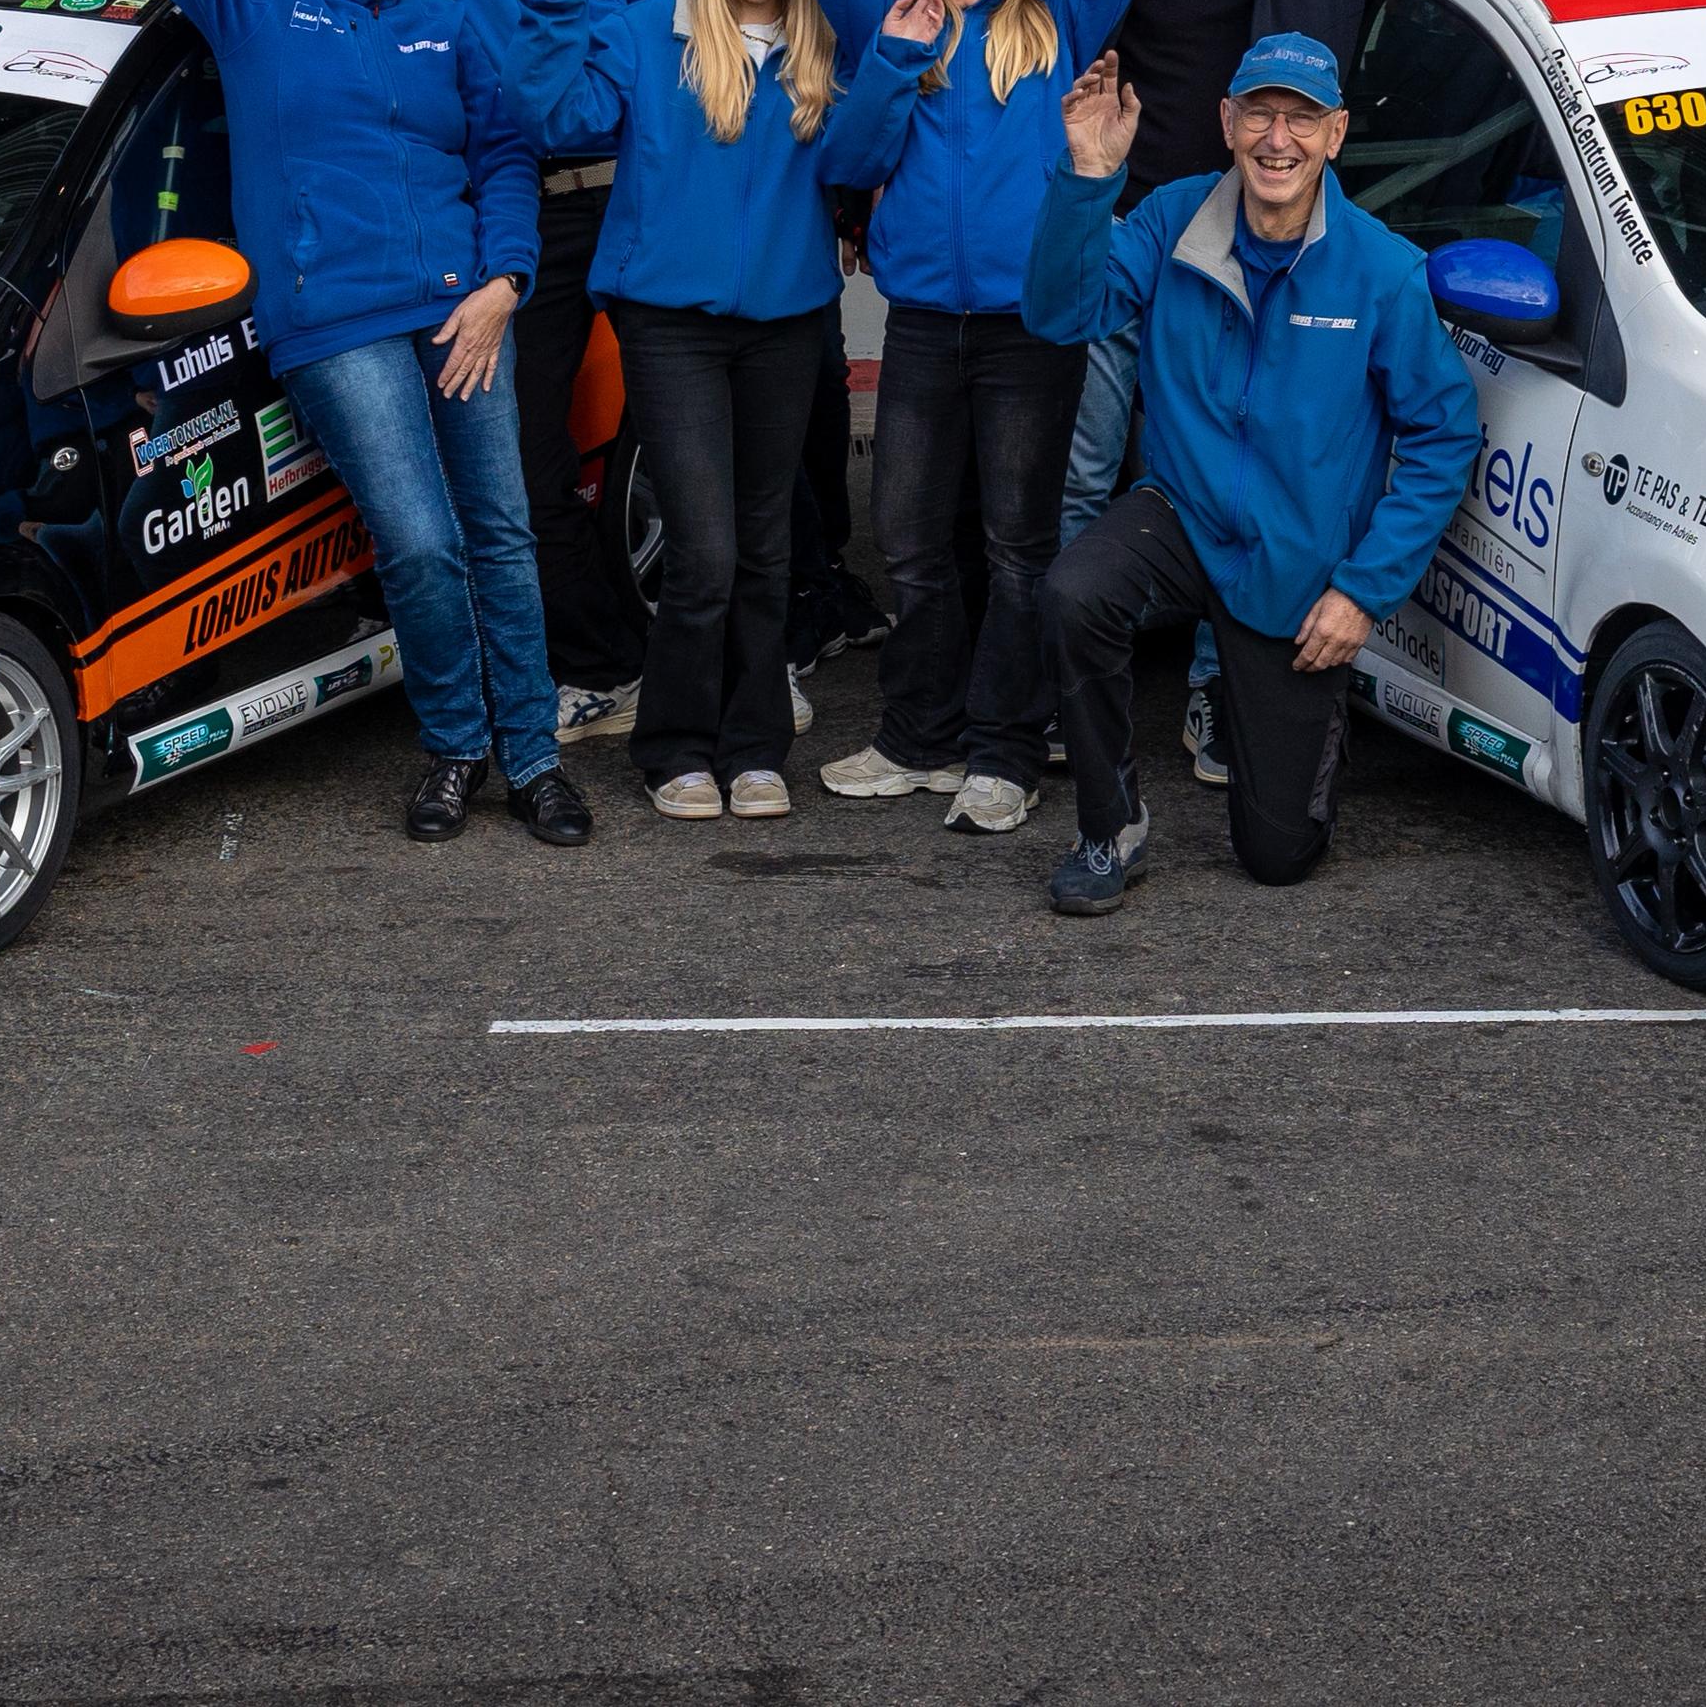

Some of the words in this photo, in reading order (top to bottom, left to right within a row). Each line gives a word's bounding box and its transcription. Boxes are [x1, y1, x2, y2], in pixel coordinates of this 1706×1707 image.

[295, 11, 318, 22] HEMA
[1273, 48, 1303, 63] AUTO
[1304, 55, 1328, 71] SPORT
[1541, 48, 1583, 117] Porsche
[1571, 112, 1623, 197] Centrum
[1608, 189, 1654, 267] Twente
[1332, 317, 1357, 329] SPORT
[158, 333, 235, 392] Lohuis
[136, 399, 239, 465] VOERTONNEN.NL
[1634, 465, 1652, 489] TE
[1654, 473, 1680, 509] PAS
[143, 477, 251, 555] Garden
[203, 519, 227, 541] HYMA
[1625, 499, 1662, 532] Accountancy
[1671, 523, 1699, 548] Advies
[183, 558, 281, 656] LOHUIS
[282, 513, 375, 602] AUTOS
[241, 684, 308, 725] EVOLVE
[1385, 683, 1440, 725] EVOLVE
[163, 724, 208, 753] SPEED
[1465, 724, 1505, 751] SPEED
